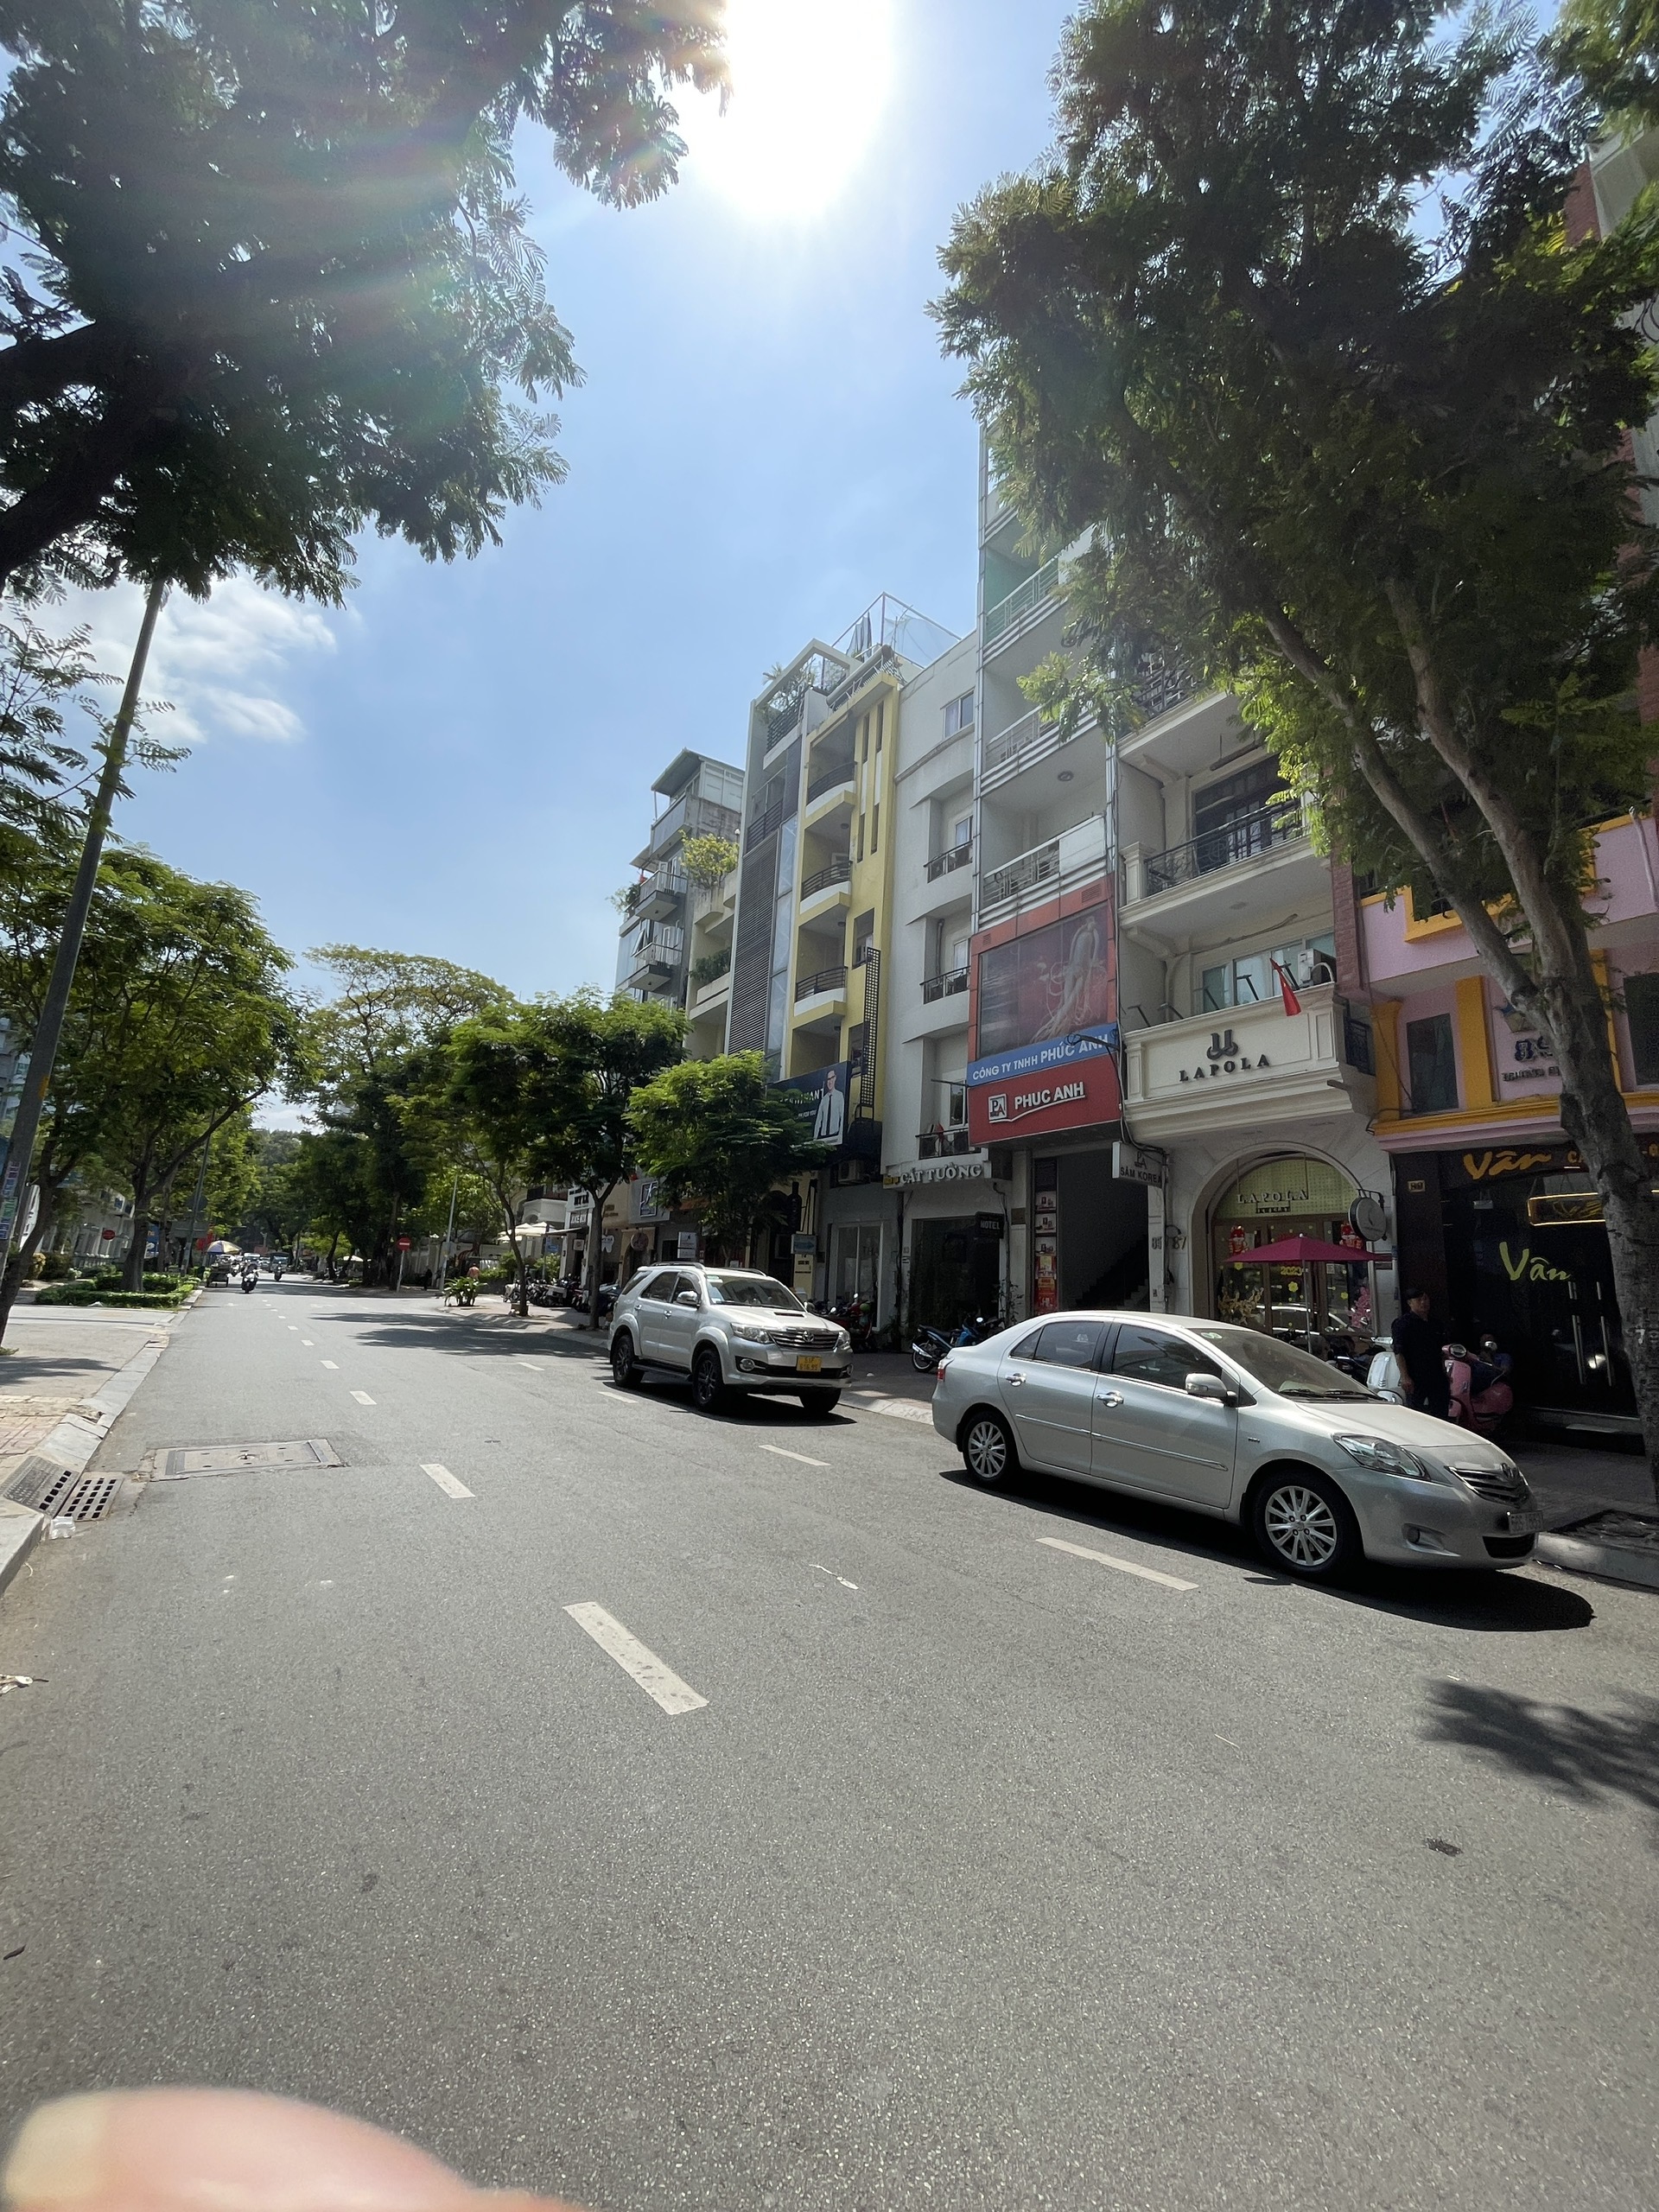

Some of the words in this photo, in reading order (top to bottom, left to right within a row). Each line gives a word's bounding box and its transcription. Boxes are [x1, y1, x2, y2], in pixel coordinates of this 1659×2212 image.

[973, 1063, 1000, 1080] CÔNG
[1001, 1063, 1012, 1073] TY
[1014, 1055, 1038, 1070] TNHH
[1040, 1042, 1075, 1064] PHÚC
[1078, 1033, 1108, 1053] ANH
[1179, 1054, 1270, 1082] LAPOLA
[1053, 1082, 1084, 1102] ANH
[927, 1162, 982, 1181] TƯỜNG
[1463, 1150, 1552, 1180] Vân
[1237, 1190, 1308, 1204] LAPOLA
[1173, 1236, 1186, 1249] 87
[1499, 1241, 1572, 1281] Vân
